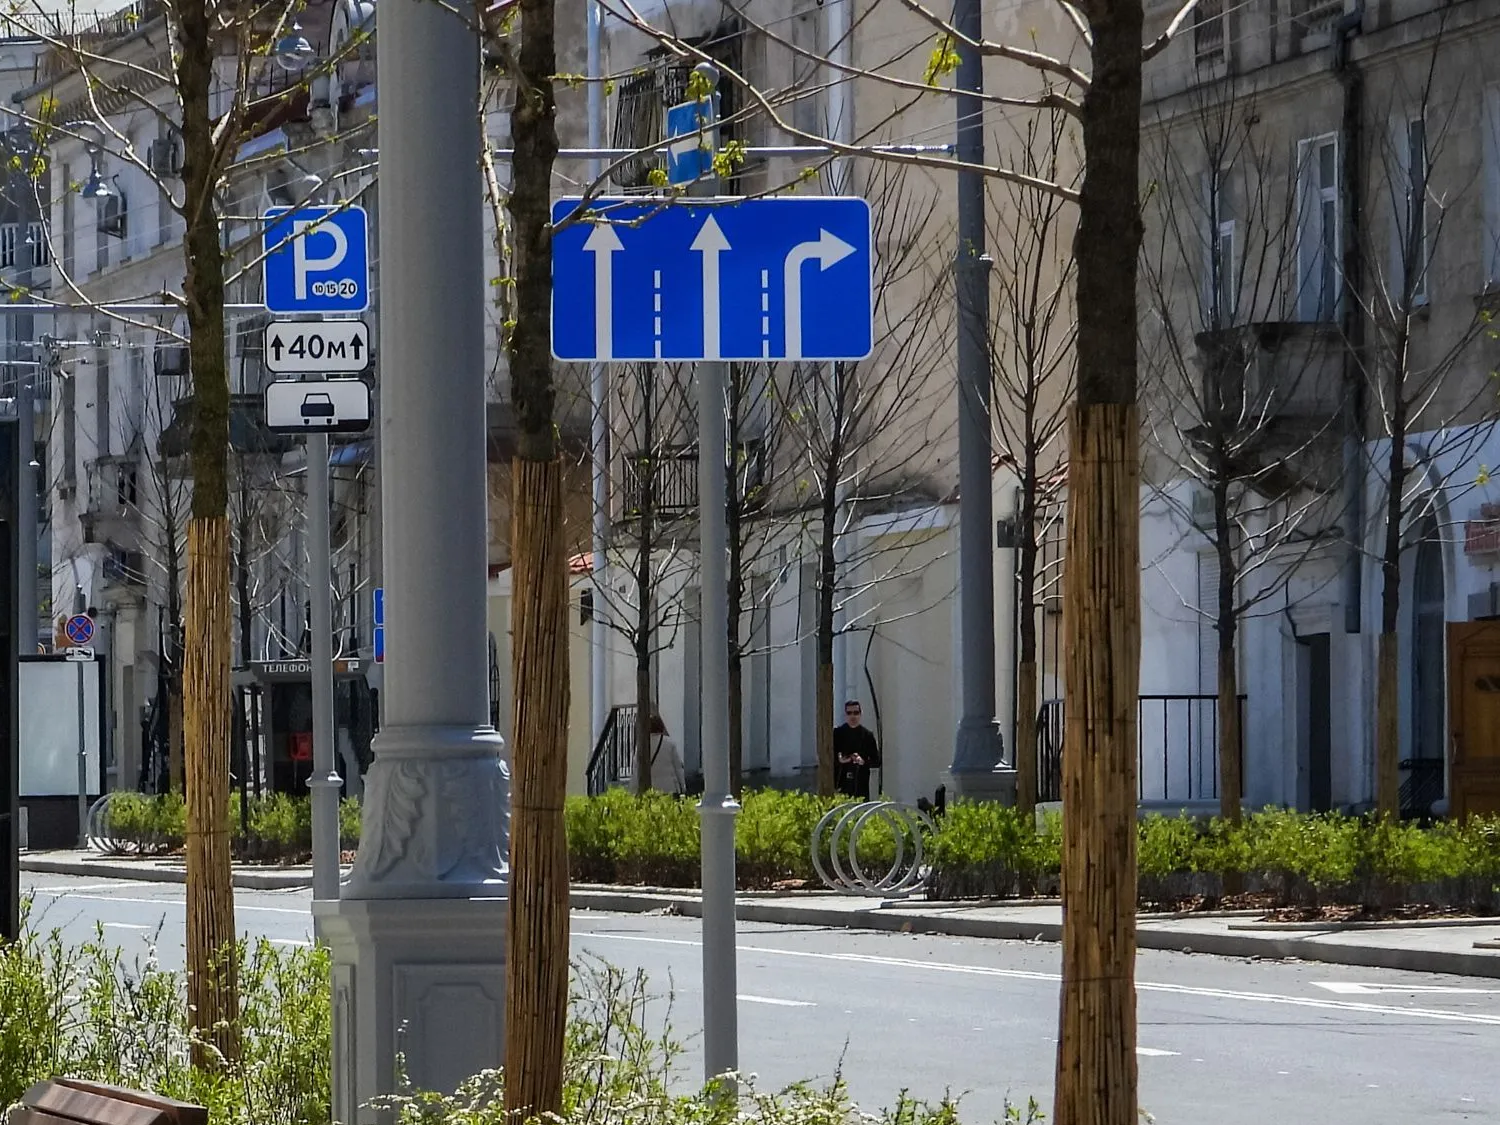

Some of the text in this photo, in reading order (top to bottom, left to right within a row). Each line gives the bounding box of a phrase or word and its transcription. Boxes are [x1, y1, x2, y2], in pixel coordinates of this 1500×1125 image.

[293, 220, 348, 299] P
[315, 283, 356, 295] 10 15 20
